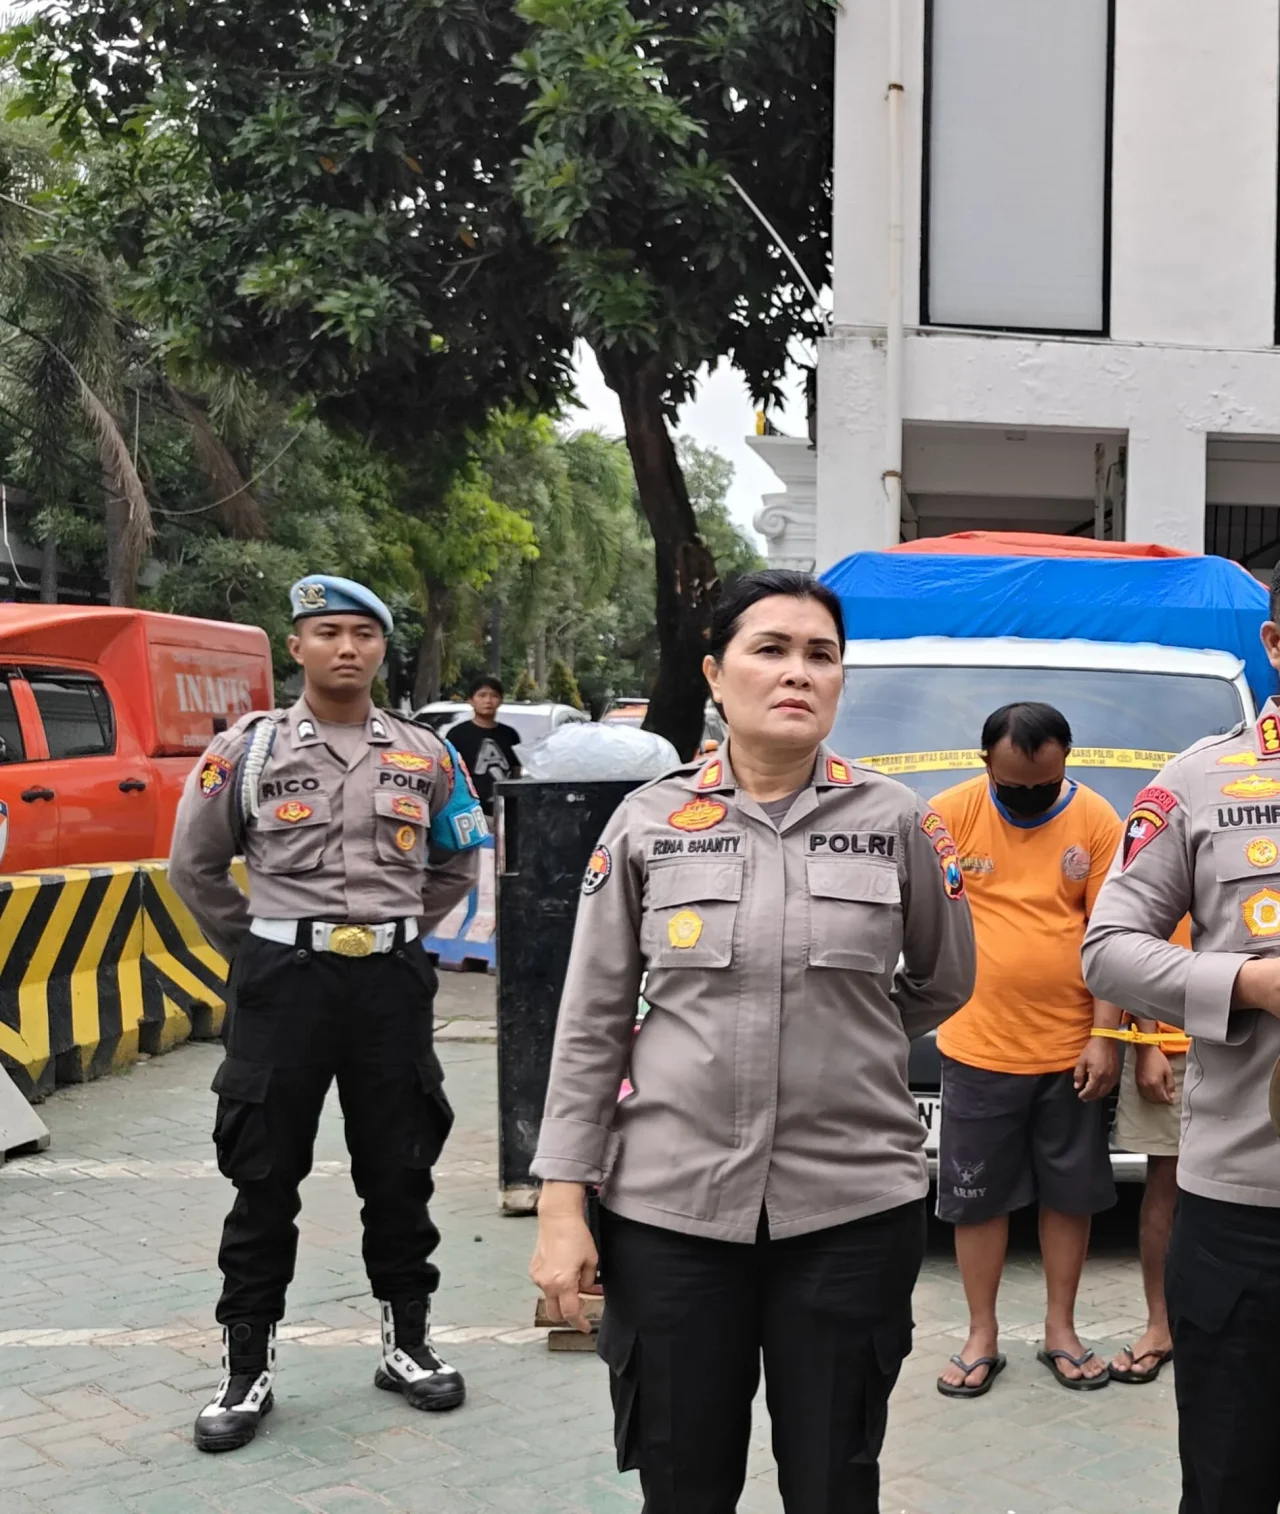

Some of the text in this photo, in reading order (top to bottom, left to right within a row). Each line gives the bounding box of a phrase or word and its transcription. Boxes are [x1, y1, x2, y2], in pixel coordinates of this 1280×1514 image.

[175, 672, 252, 714] INAFIS
[261, 778, 320, 798] RICO
[380, 772, 431, 795] POLRI
[653, 836, 740, 855] RINA SHANTY
[809, 833, 894, 856] POLRI
[953, 1186, 988, 1198] ARMY
